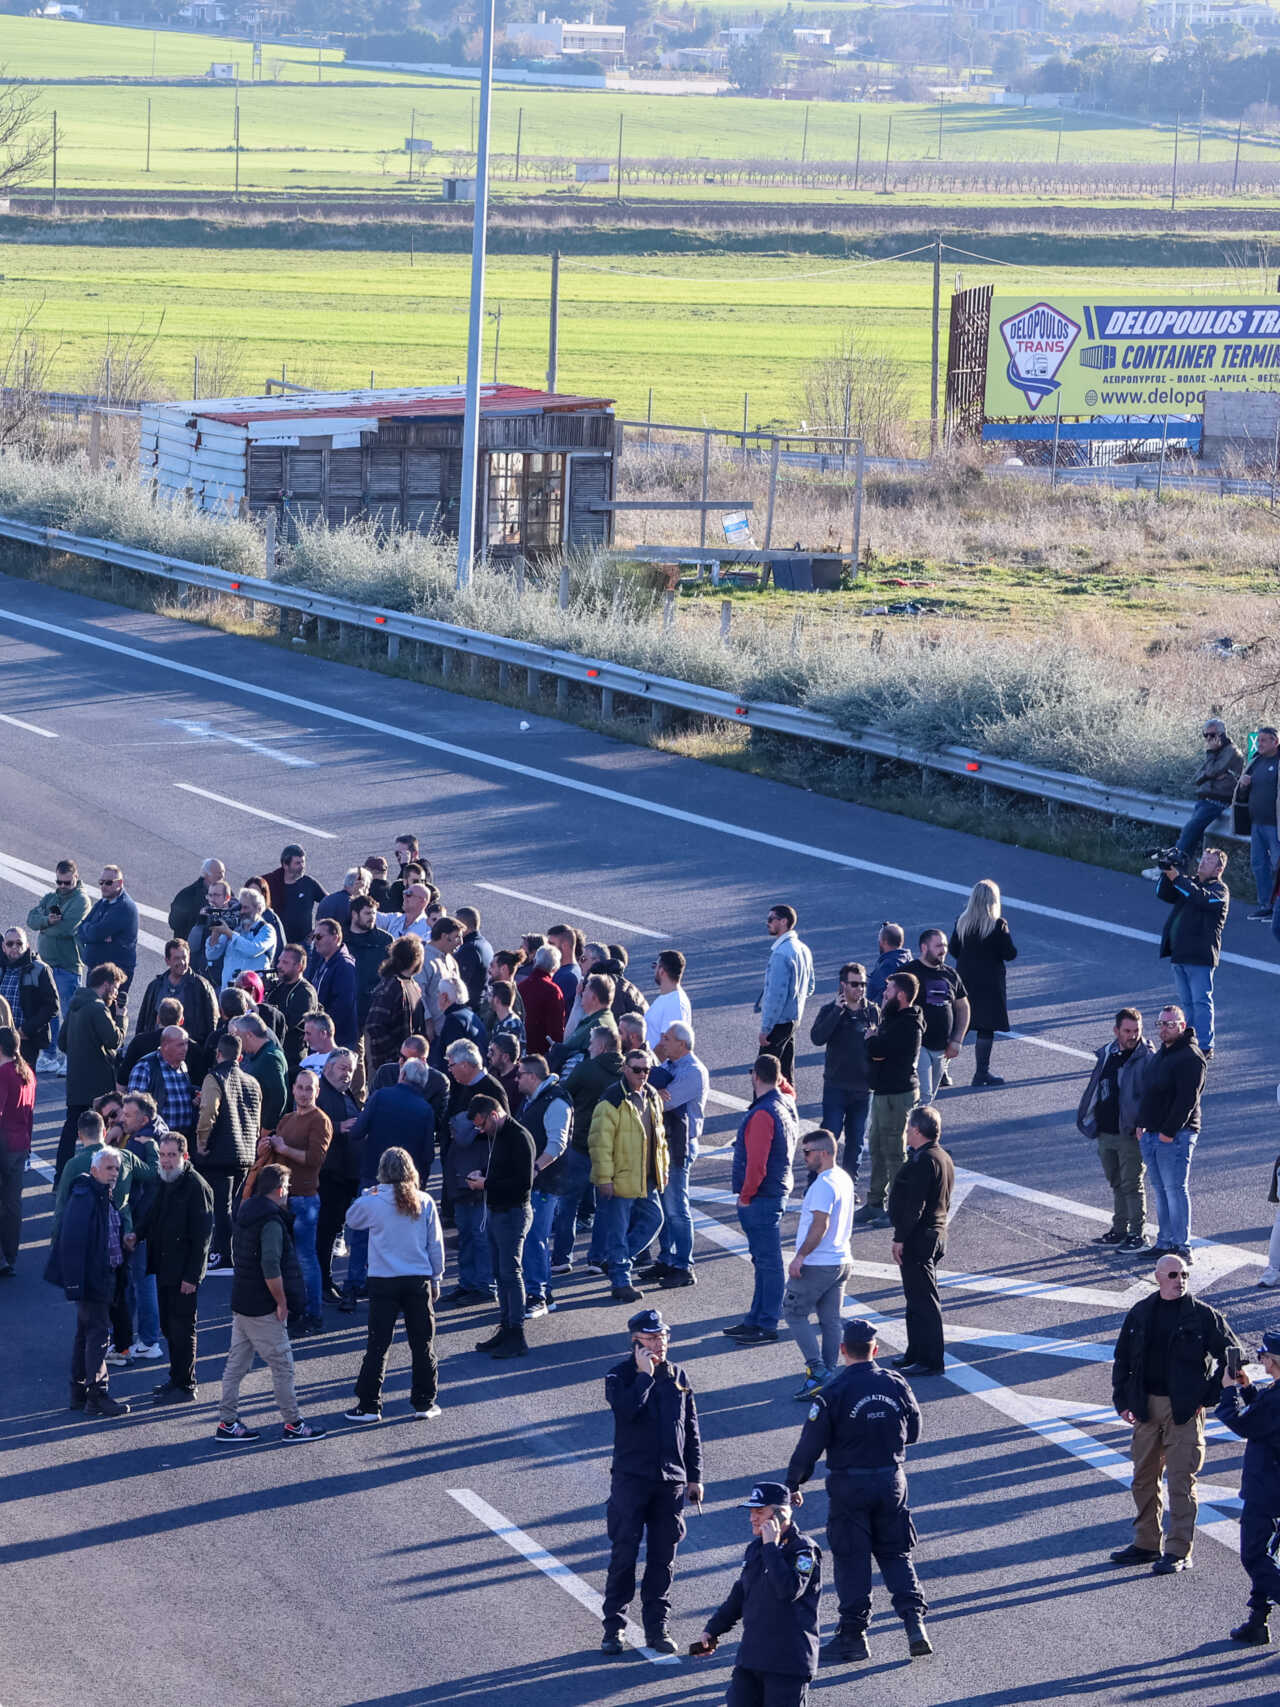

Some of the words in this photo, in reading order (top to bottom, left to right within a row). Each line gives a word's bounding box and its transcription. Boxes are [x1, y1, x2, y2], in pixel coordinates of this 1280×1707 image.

[1010, 310, 1069, 339] DELOPOULOS
[1104, 310, 1247, 335] DELOPOULOS
[1016, 340, 1065, 352] TRANS
[1121, 345, 1217, 369] CONTAINER
